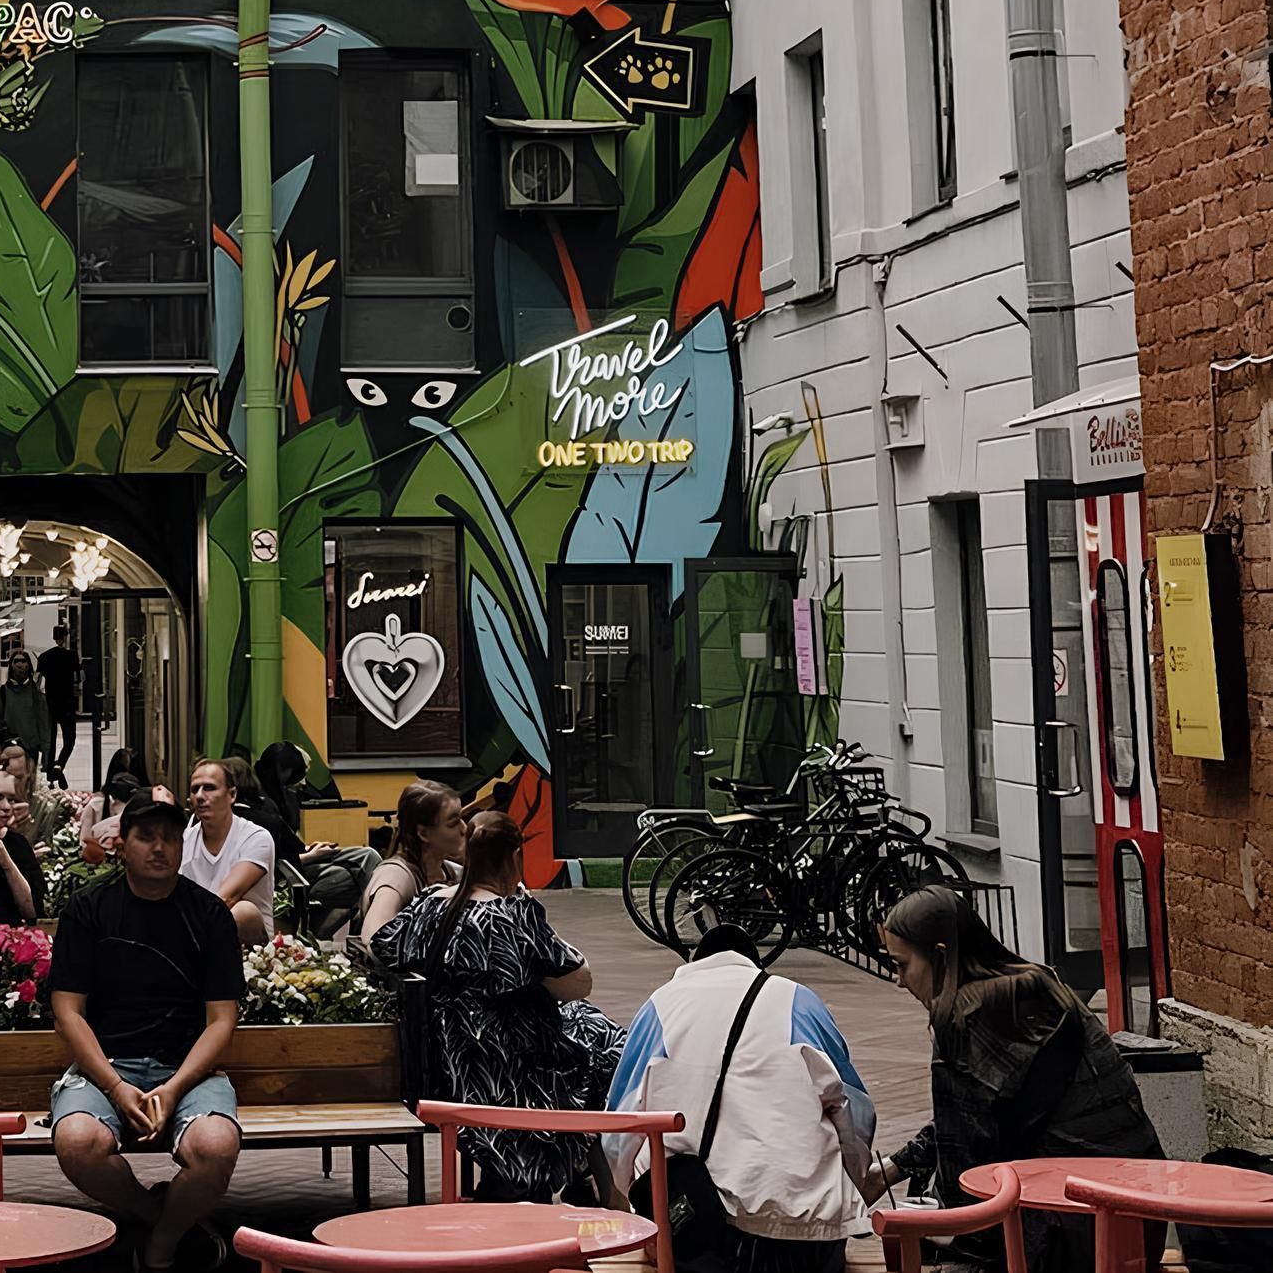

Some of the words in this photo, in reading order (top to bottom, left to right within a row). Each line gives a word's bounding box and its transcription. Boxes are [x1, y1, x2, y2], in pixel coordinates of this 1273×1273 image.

[519, 314, 684, 398] Travel
[538, 440, 586, 467] ONE
[589, 440, 645, 464] TWO
[645, 438, 694, 463] TRIP
